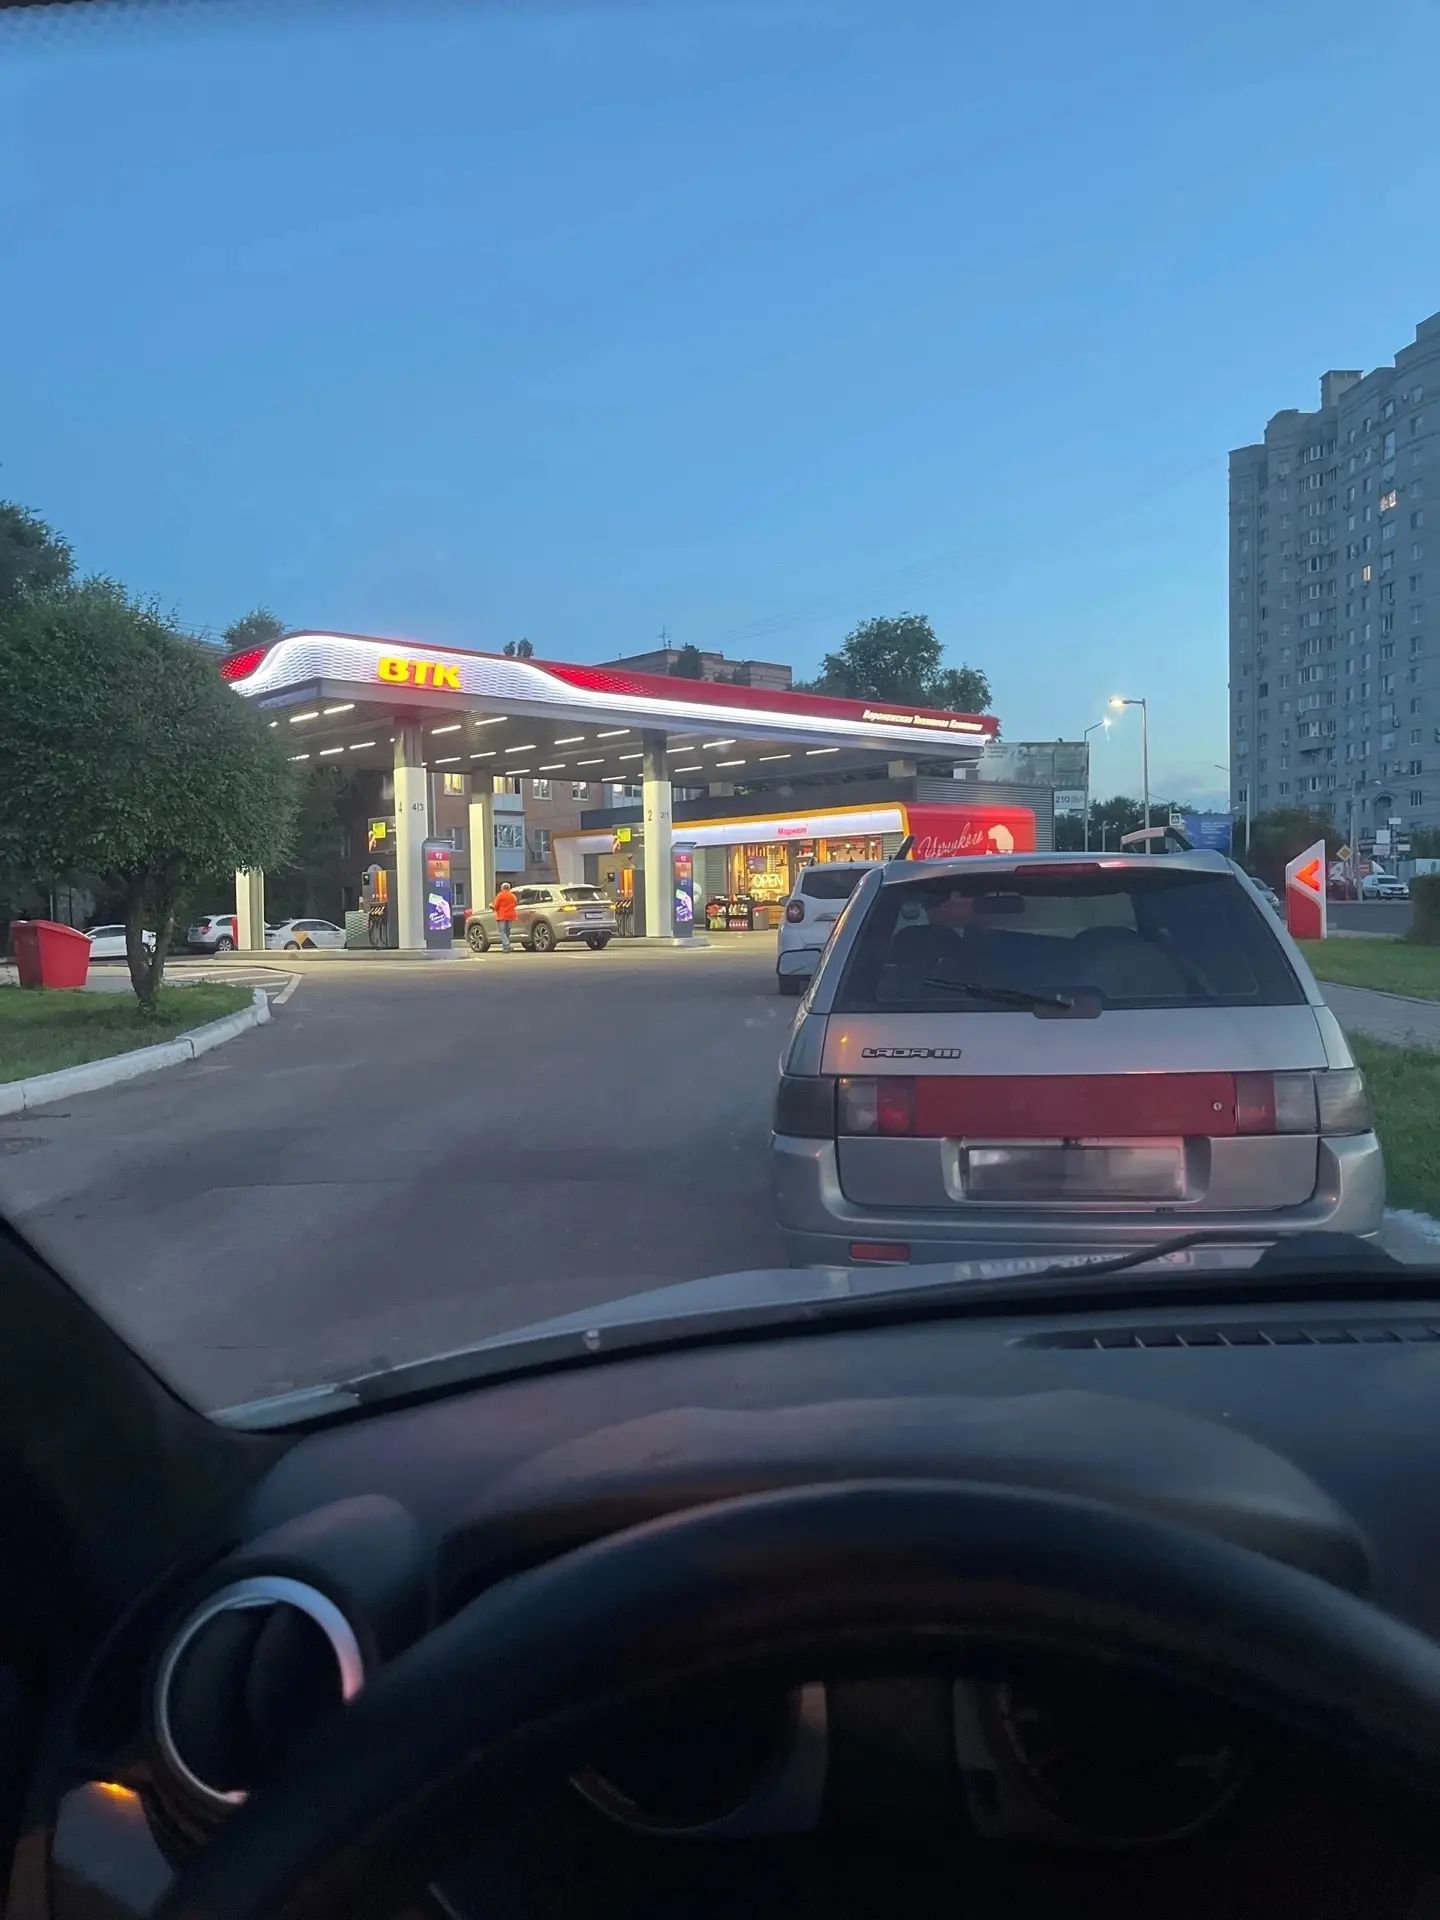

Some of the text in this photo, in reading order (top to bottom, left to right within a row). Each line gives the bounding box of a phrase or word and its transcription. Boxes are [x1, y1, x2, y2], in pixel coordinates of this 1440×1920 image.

[378, 656, 462, 689] ВТК
[647, 809, 653, 821] 2
[434, 851, 443, 859] 92
[753, 873, 783, 888] OPEN
[861, 1048, 929, 1058] LADA
